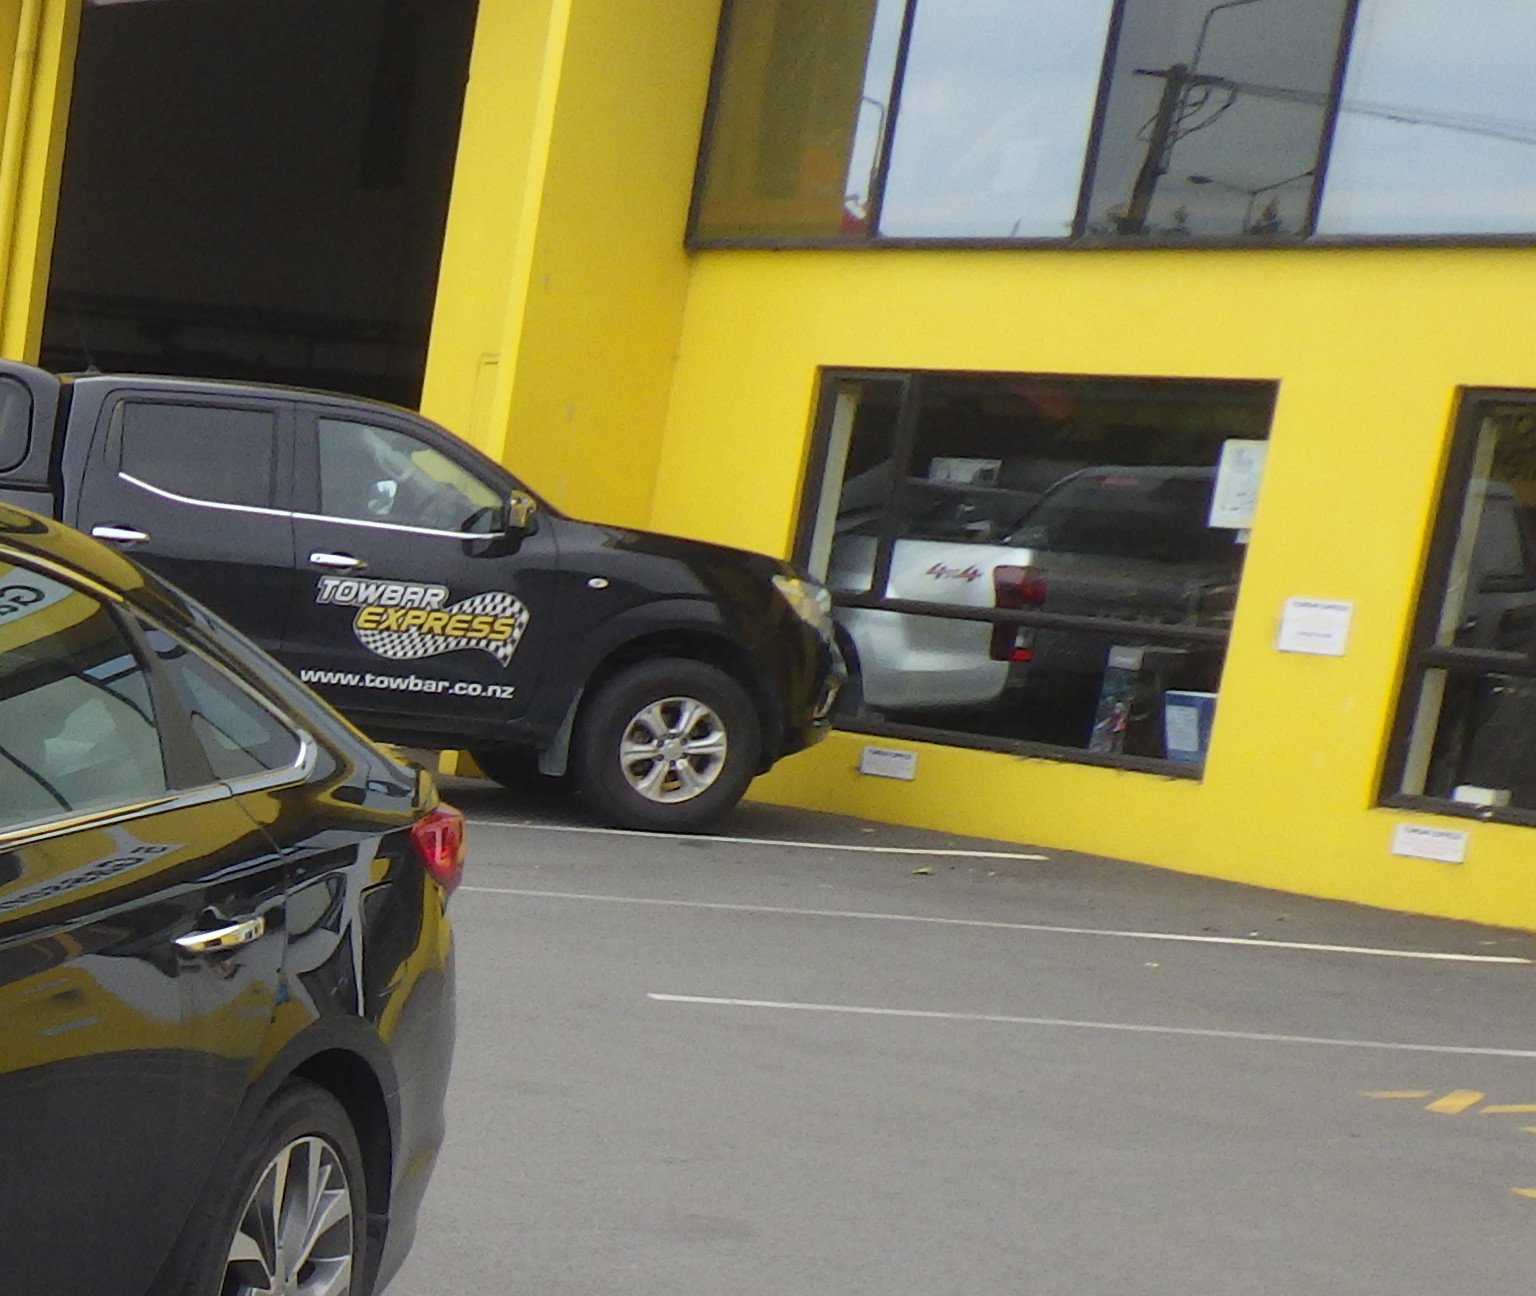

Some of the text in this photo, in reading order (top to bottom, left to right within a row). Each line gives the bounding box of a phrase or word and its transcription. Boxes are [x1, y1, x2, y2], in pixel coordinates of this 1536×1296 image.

[320, 579, 447, 610] TOWBAR
[356, 606, 517, 640] EXPRESS
[300, 669, 516, 699] www.towbar.co.nz
